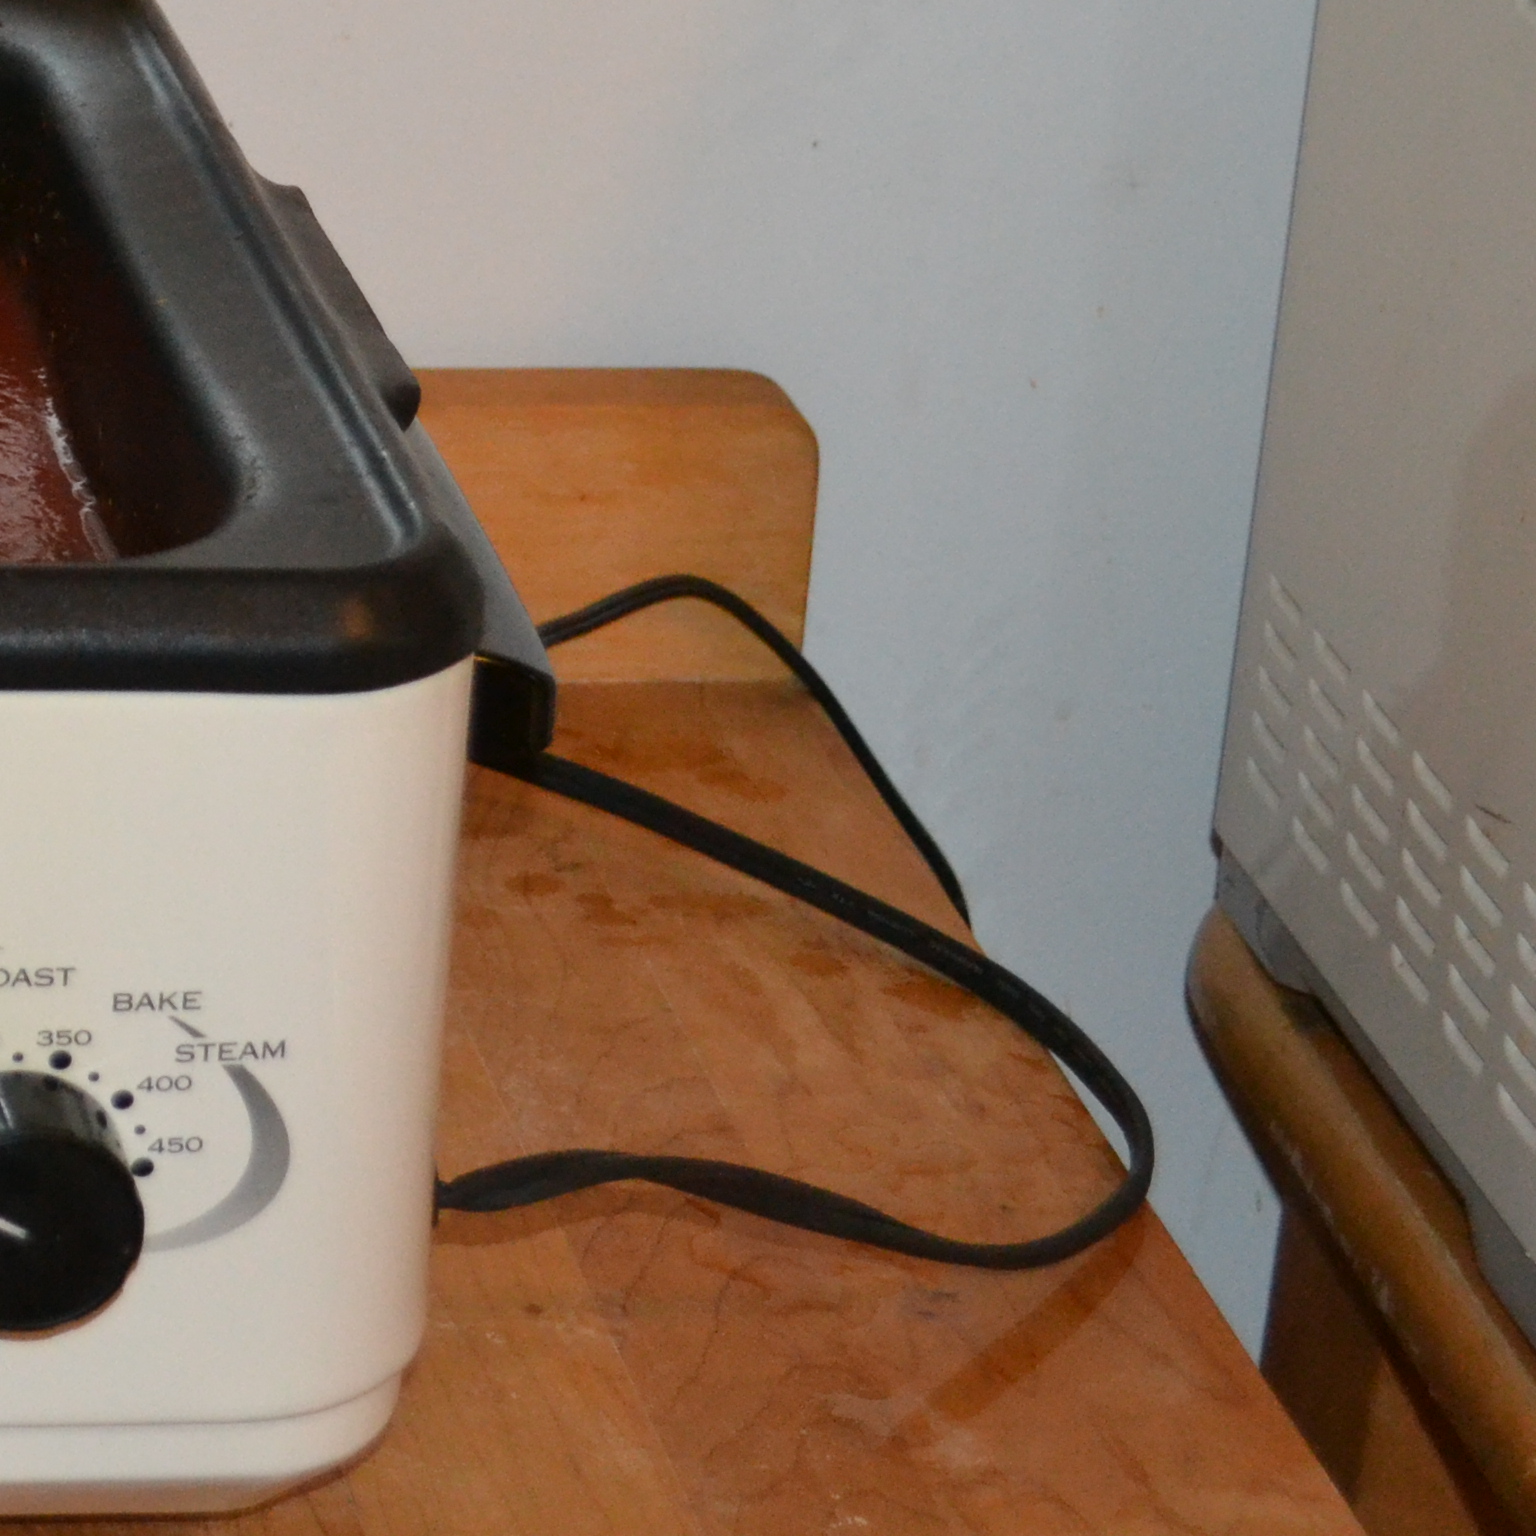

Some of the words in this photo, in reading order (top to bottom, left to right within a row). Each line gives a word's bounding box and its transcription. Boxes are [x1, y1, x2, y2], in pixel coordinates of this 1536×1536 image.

[111, 990, 203, 1013] BAKE
[36, 1028, 93, 1047] 350
[174, 1039, 288, 1063] STEAM
[136, 1075, 193, 1092] 400
[147, 1136, 204, 1154] 450
